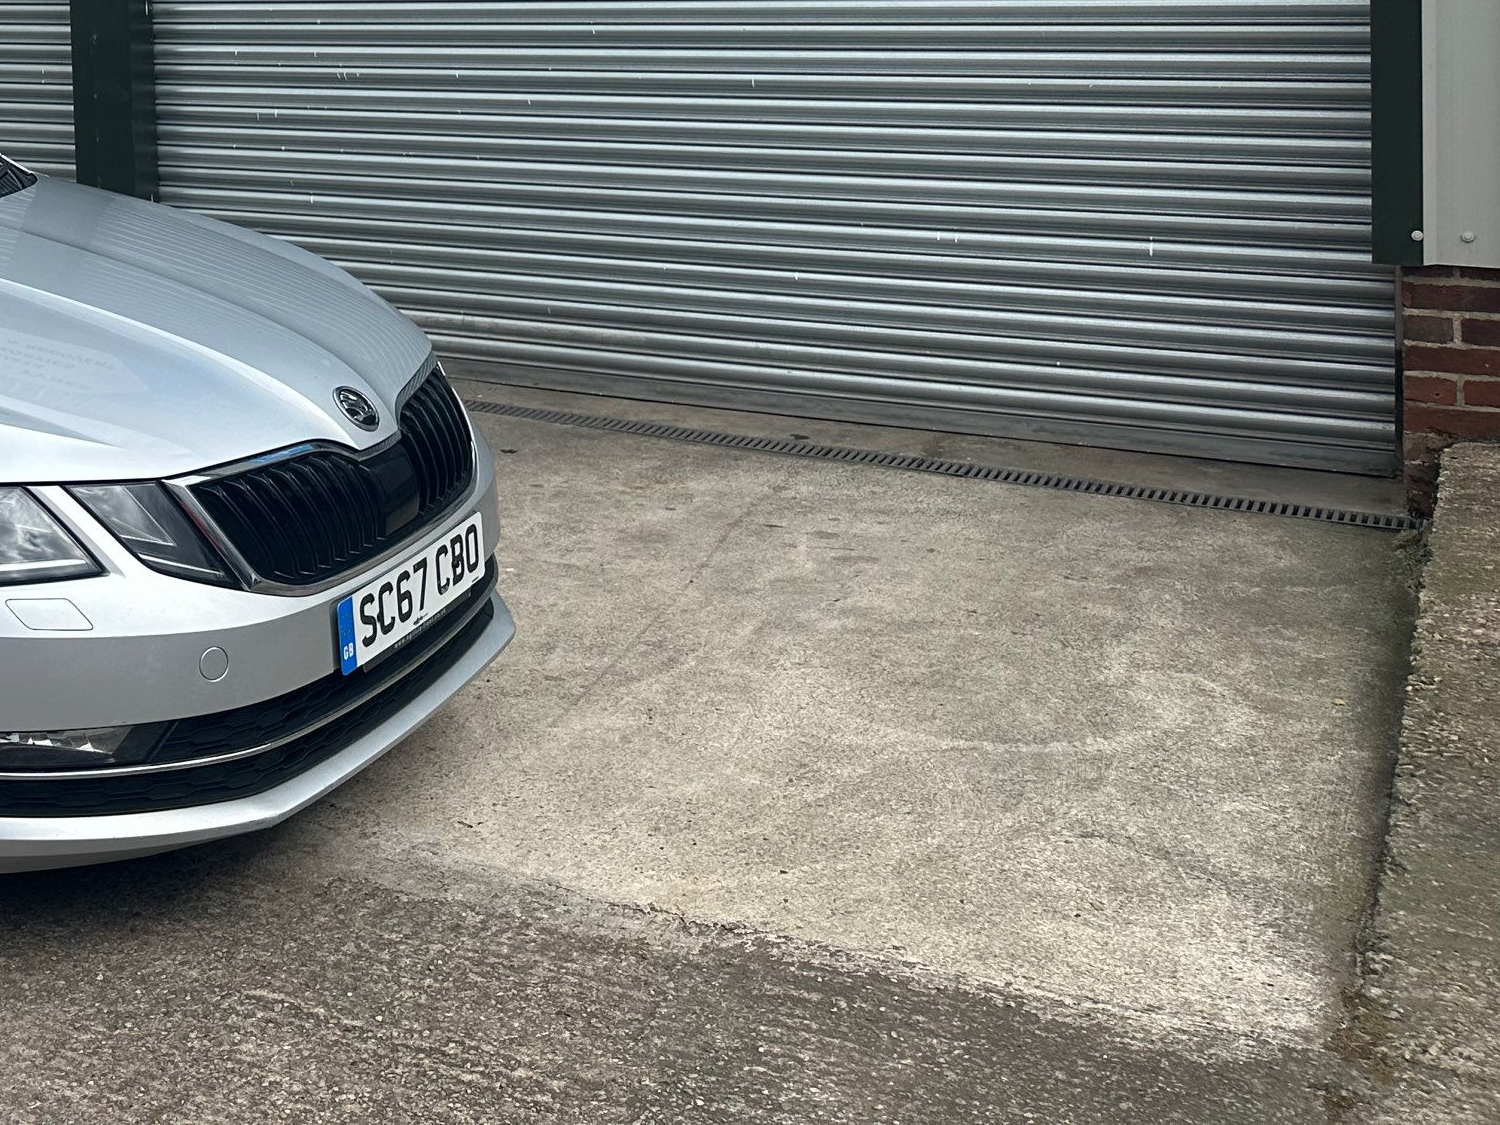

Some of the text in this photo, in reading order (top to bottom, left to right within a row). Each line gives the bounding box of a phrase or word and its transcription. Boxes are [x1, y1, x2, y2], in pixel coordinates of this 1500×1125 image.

[359, 557, 429, 648] SC67
[436, 523, 480, 596] CBO
[343, 641, 354, 661] GB
